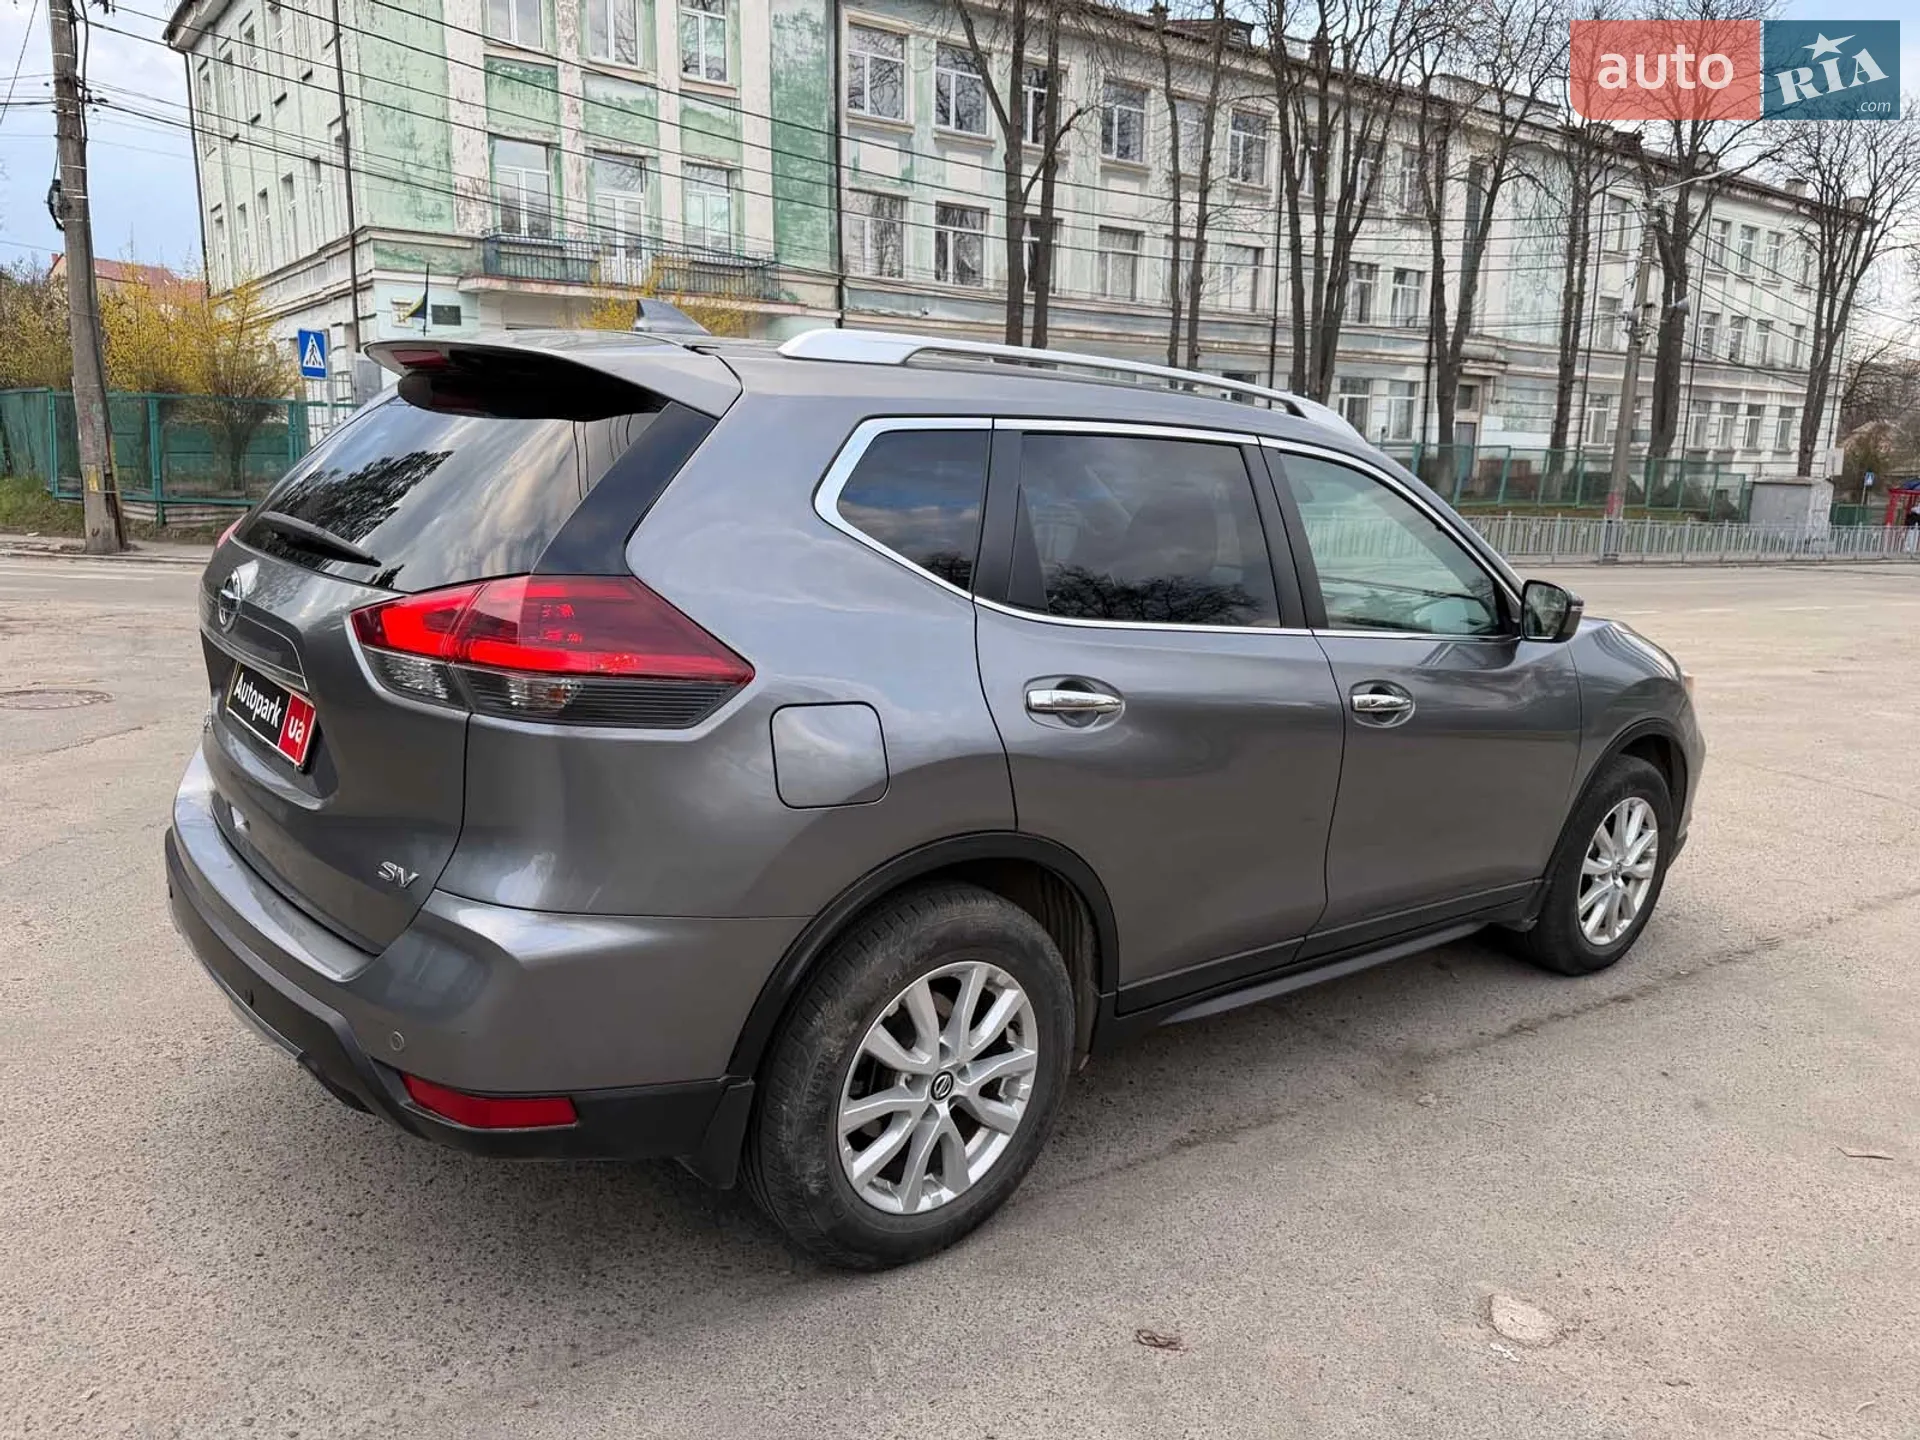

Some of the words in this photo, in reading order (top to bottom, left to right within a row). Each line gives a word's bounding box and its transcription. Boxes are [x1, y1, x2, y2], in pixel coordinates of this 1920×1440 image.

[233, 672, 281, 728] Autopark
[288, 715, 305, 744] ua
[378, 861, 419, 888] SV
